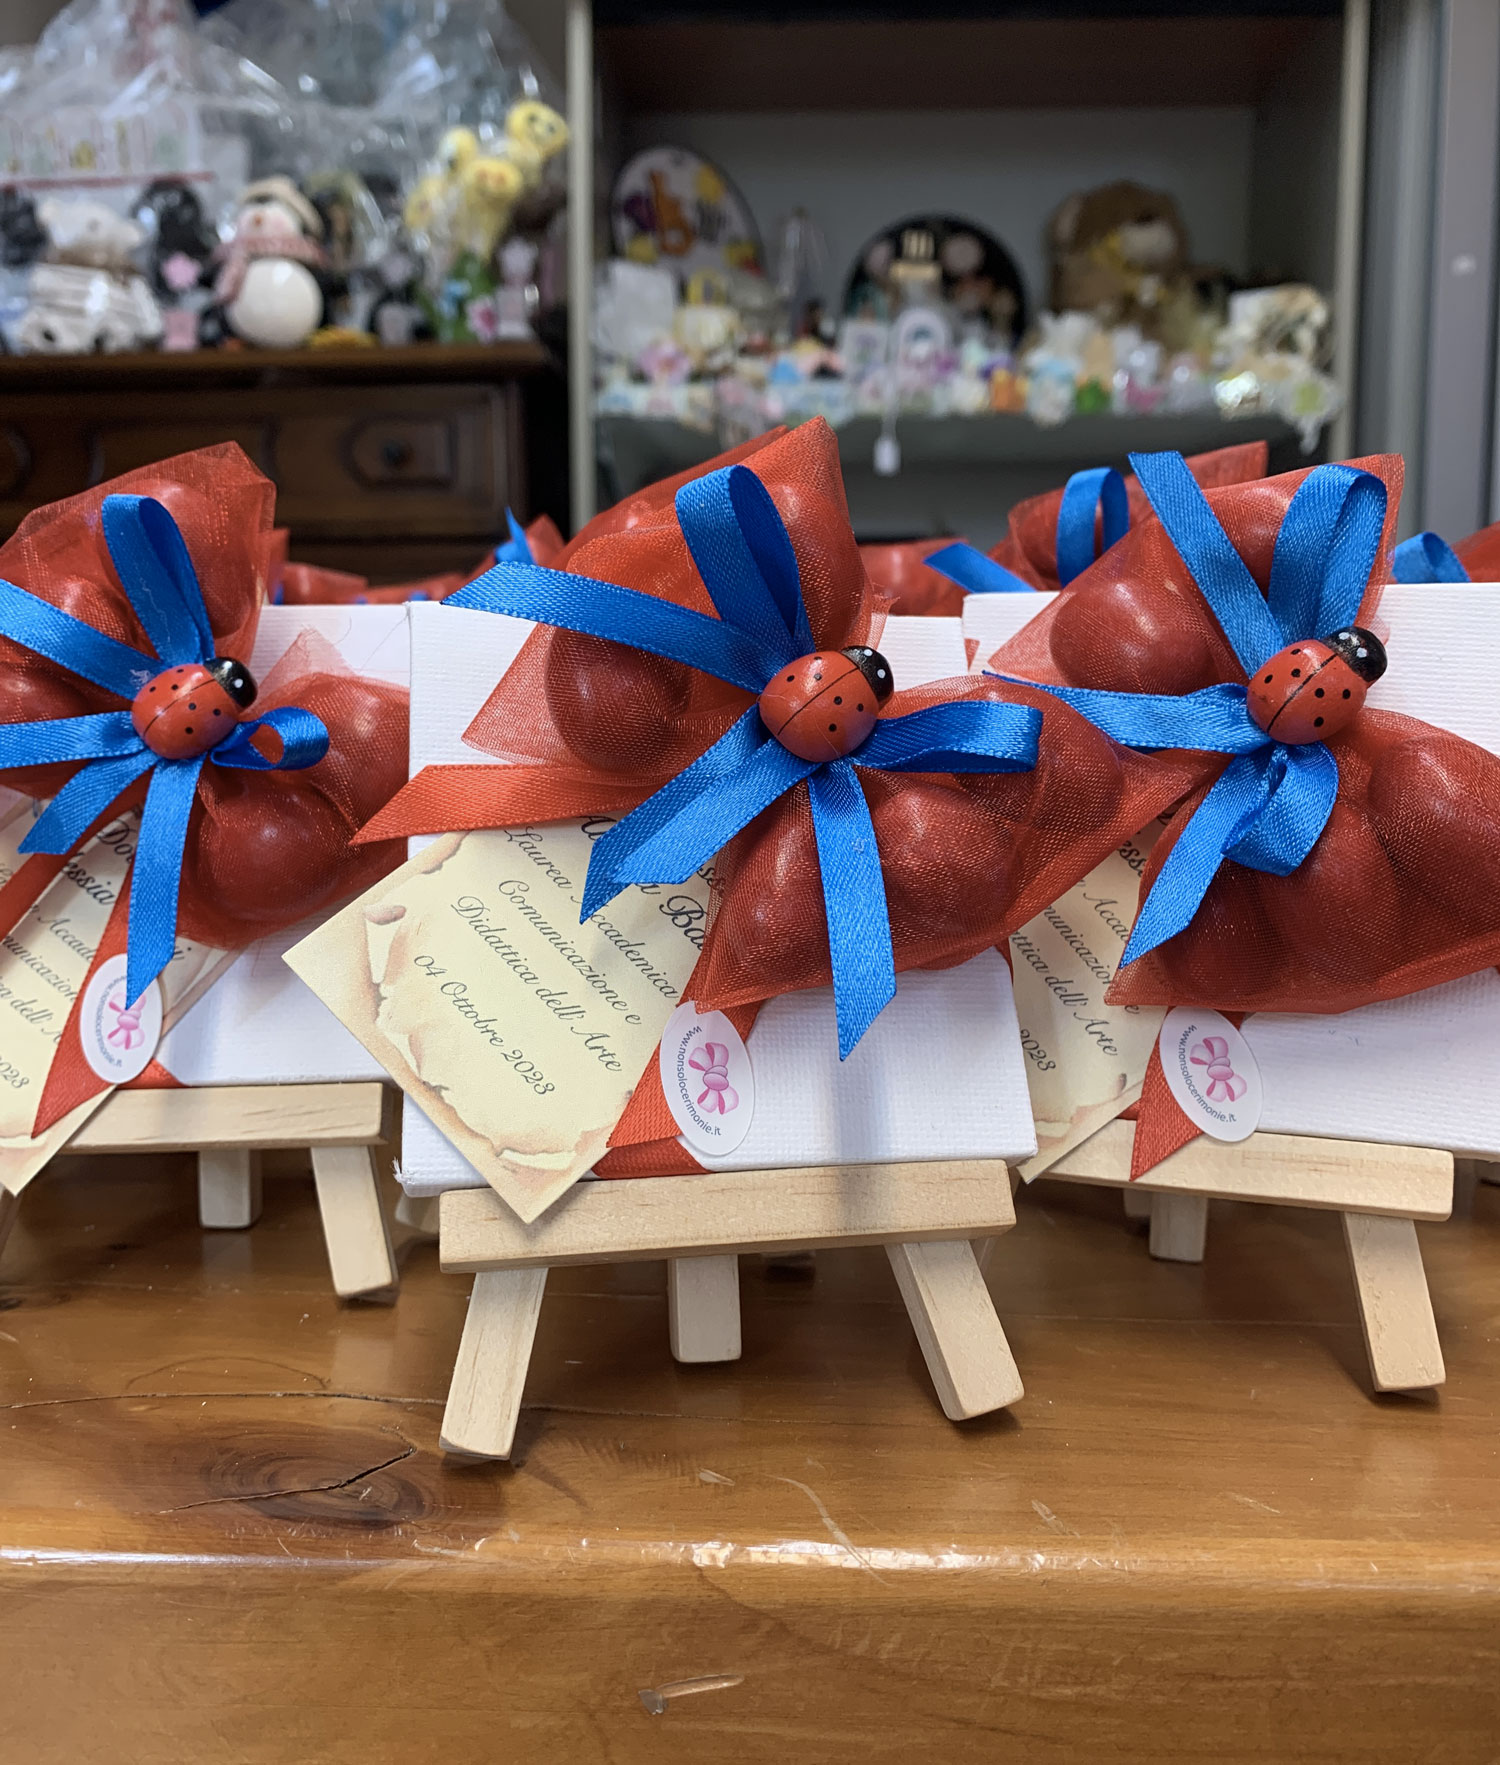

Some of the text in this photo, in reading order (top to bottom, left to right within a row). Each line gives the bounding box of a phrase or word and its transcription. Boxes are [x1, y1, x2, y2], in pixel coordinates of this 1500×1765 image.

[498, 880, 629, 1011] Comunicazione
[625, 1013, 642, 1025] e
[504, 826, 572, 889] Laurea
[570, 895, 679, 999] ccademica
[414, 955, 556, 1096] 04 Ottobre 2023
[450, 895, 623, 1072] Didattica dell' Arte
[1044, 975, 1089, 1007] dell'
[1073, 1011, 1118, 1056] Arte
[0, 1055, 30, 1089] 023
[676, 1025, 722, 1136] www.nonsolocerimonie.it
[1020, 1029, 1056, 1071] 2023
[1178, 1024, 1237, 1123] www.nonsolocerimonie.it
